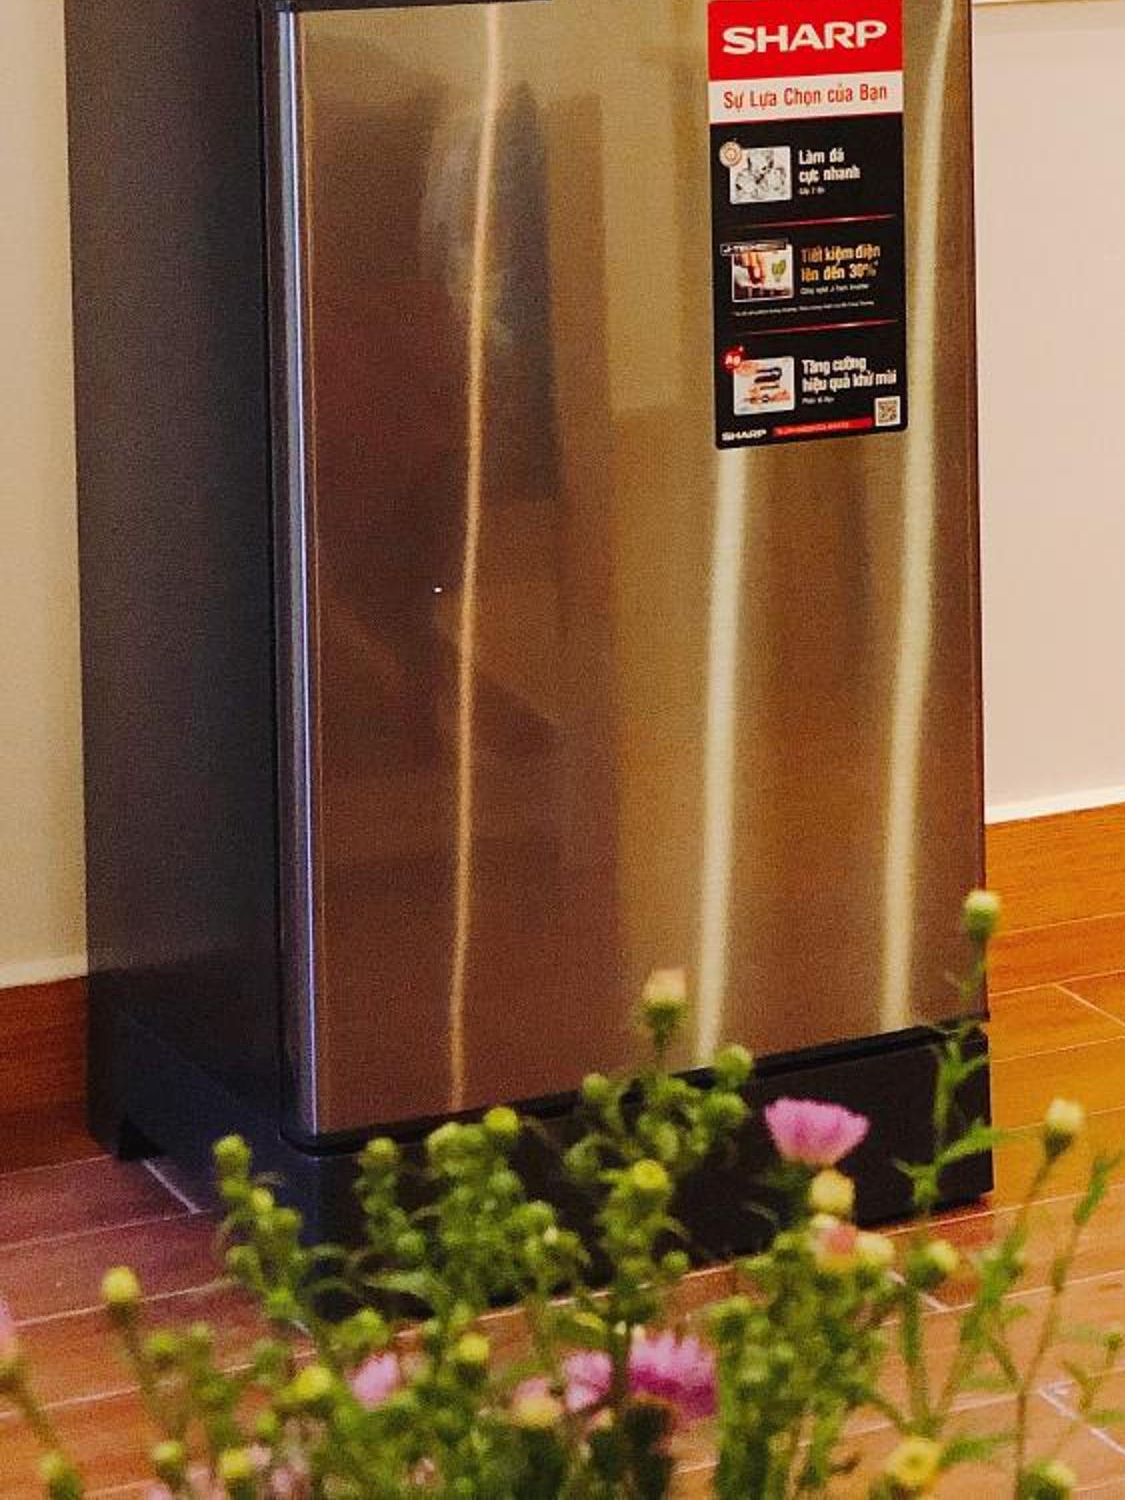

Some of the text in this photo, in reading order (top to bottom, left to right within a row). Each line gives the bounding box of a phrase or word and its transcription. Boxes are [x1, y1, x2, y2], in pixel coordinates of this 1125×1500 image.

[722, 19, 888, 55] SHARP
[723, 83, 888, 112] Sự Lựa Chọn của Bạn
[799, 148, 825, 165] Làm
[823, 164, 861, 181] nhanh
[721, 428, 767, 441] SHARP
